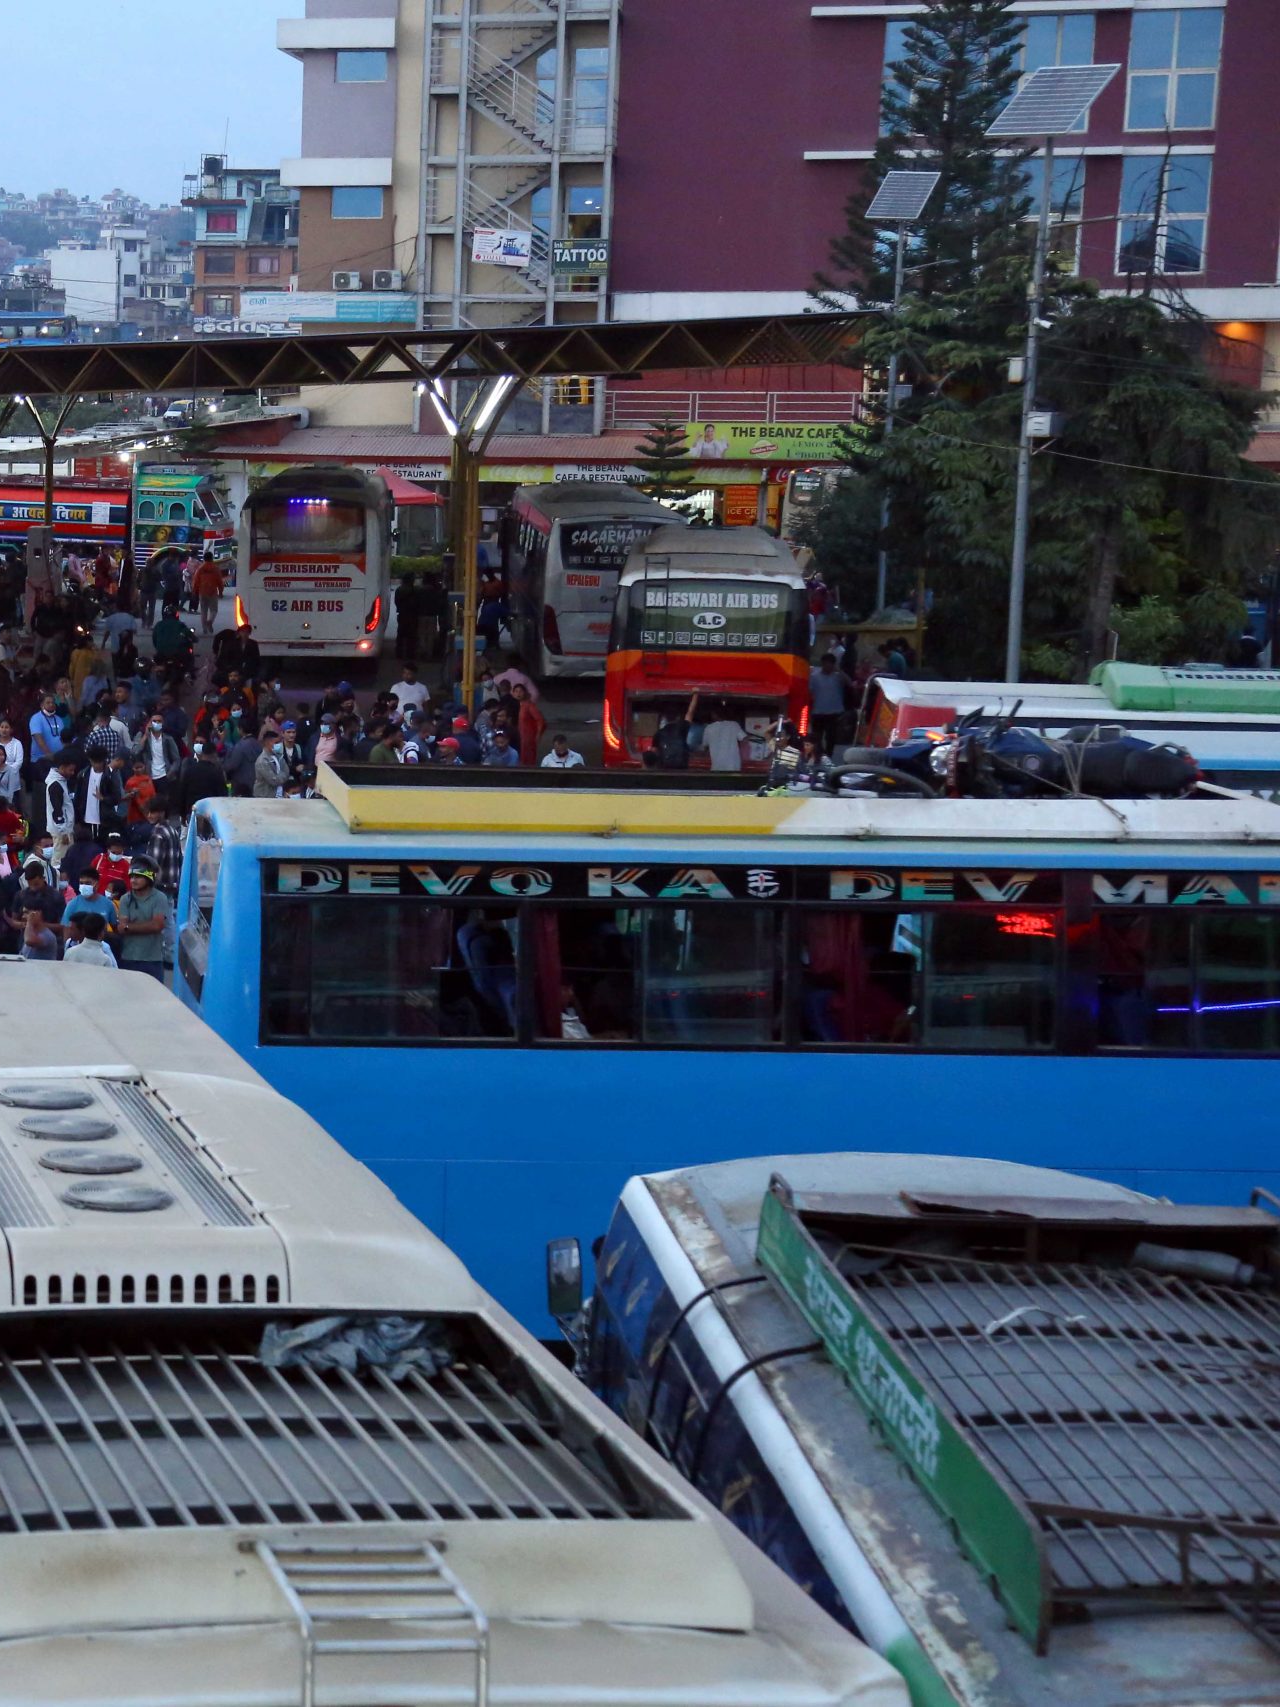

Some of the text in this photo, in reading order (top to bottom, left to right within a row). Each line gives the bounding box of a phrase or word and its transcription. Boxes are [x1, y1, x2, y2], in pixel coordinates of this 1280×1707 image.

[553, 248, 607, 262] TATTOO
[731, 426, 839, 439] THE BEANZ CAFE
[576, 464, 626, 472] THE BEANZ
[393, 470, 443, 478] ESTAURANT
[554, 473, 579, 481] CAFE
[588, 473, 646, 482] RESTAURANT
[727, 507, 743, 515] ICE
[273, 564, 340, 574] SHRISHANT
[271, 600, 344, 612] 62 AIR BUS
[725, 592, 750, 608] AIR
[751, 593, 779, 609] BUS
[829, 871, 1037, 902] DEV
